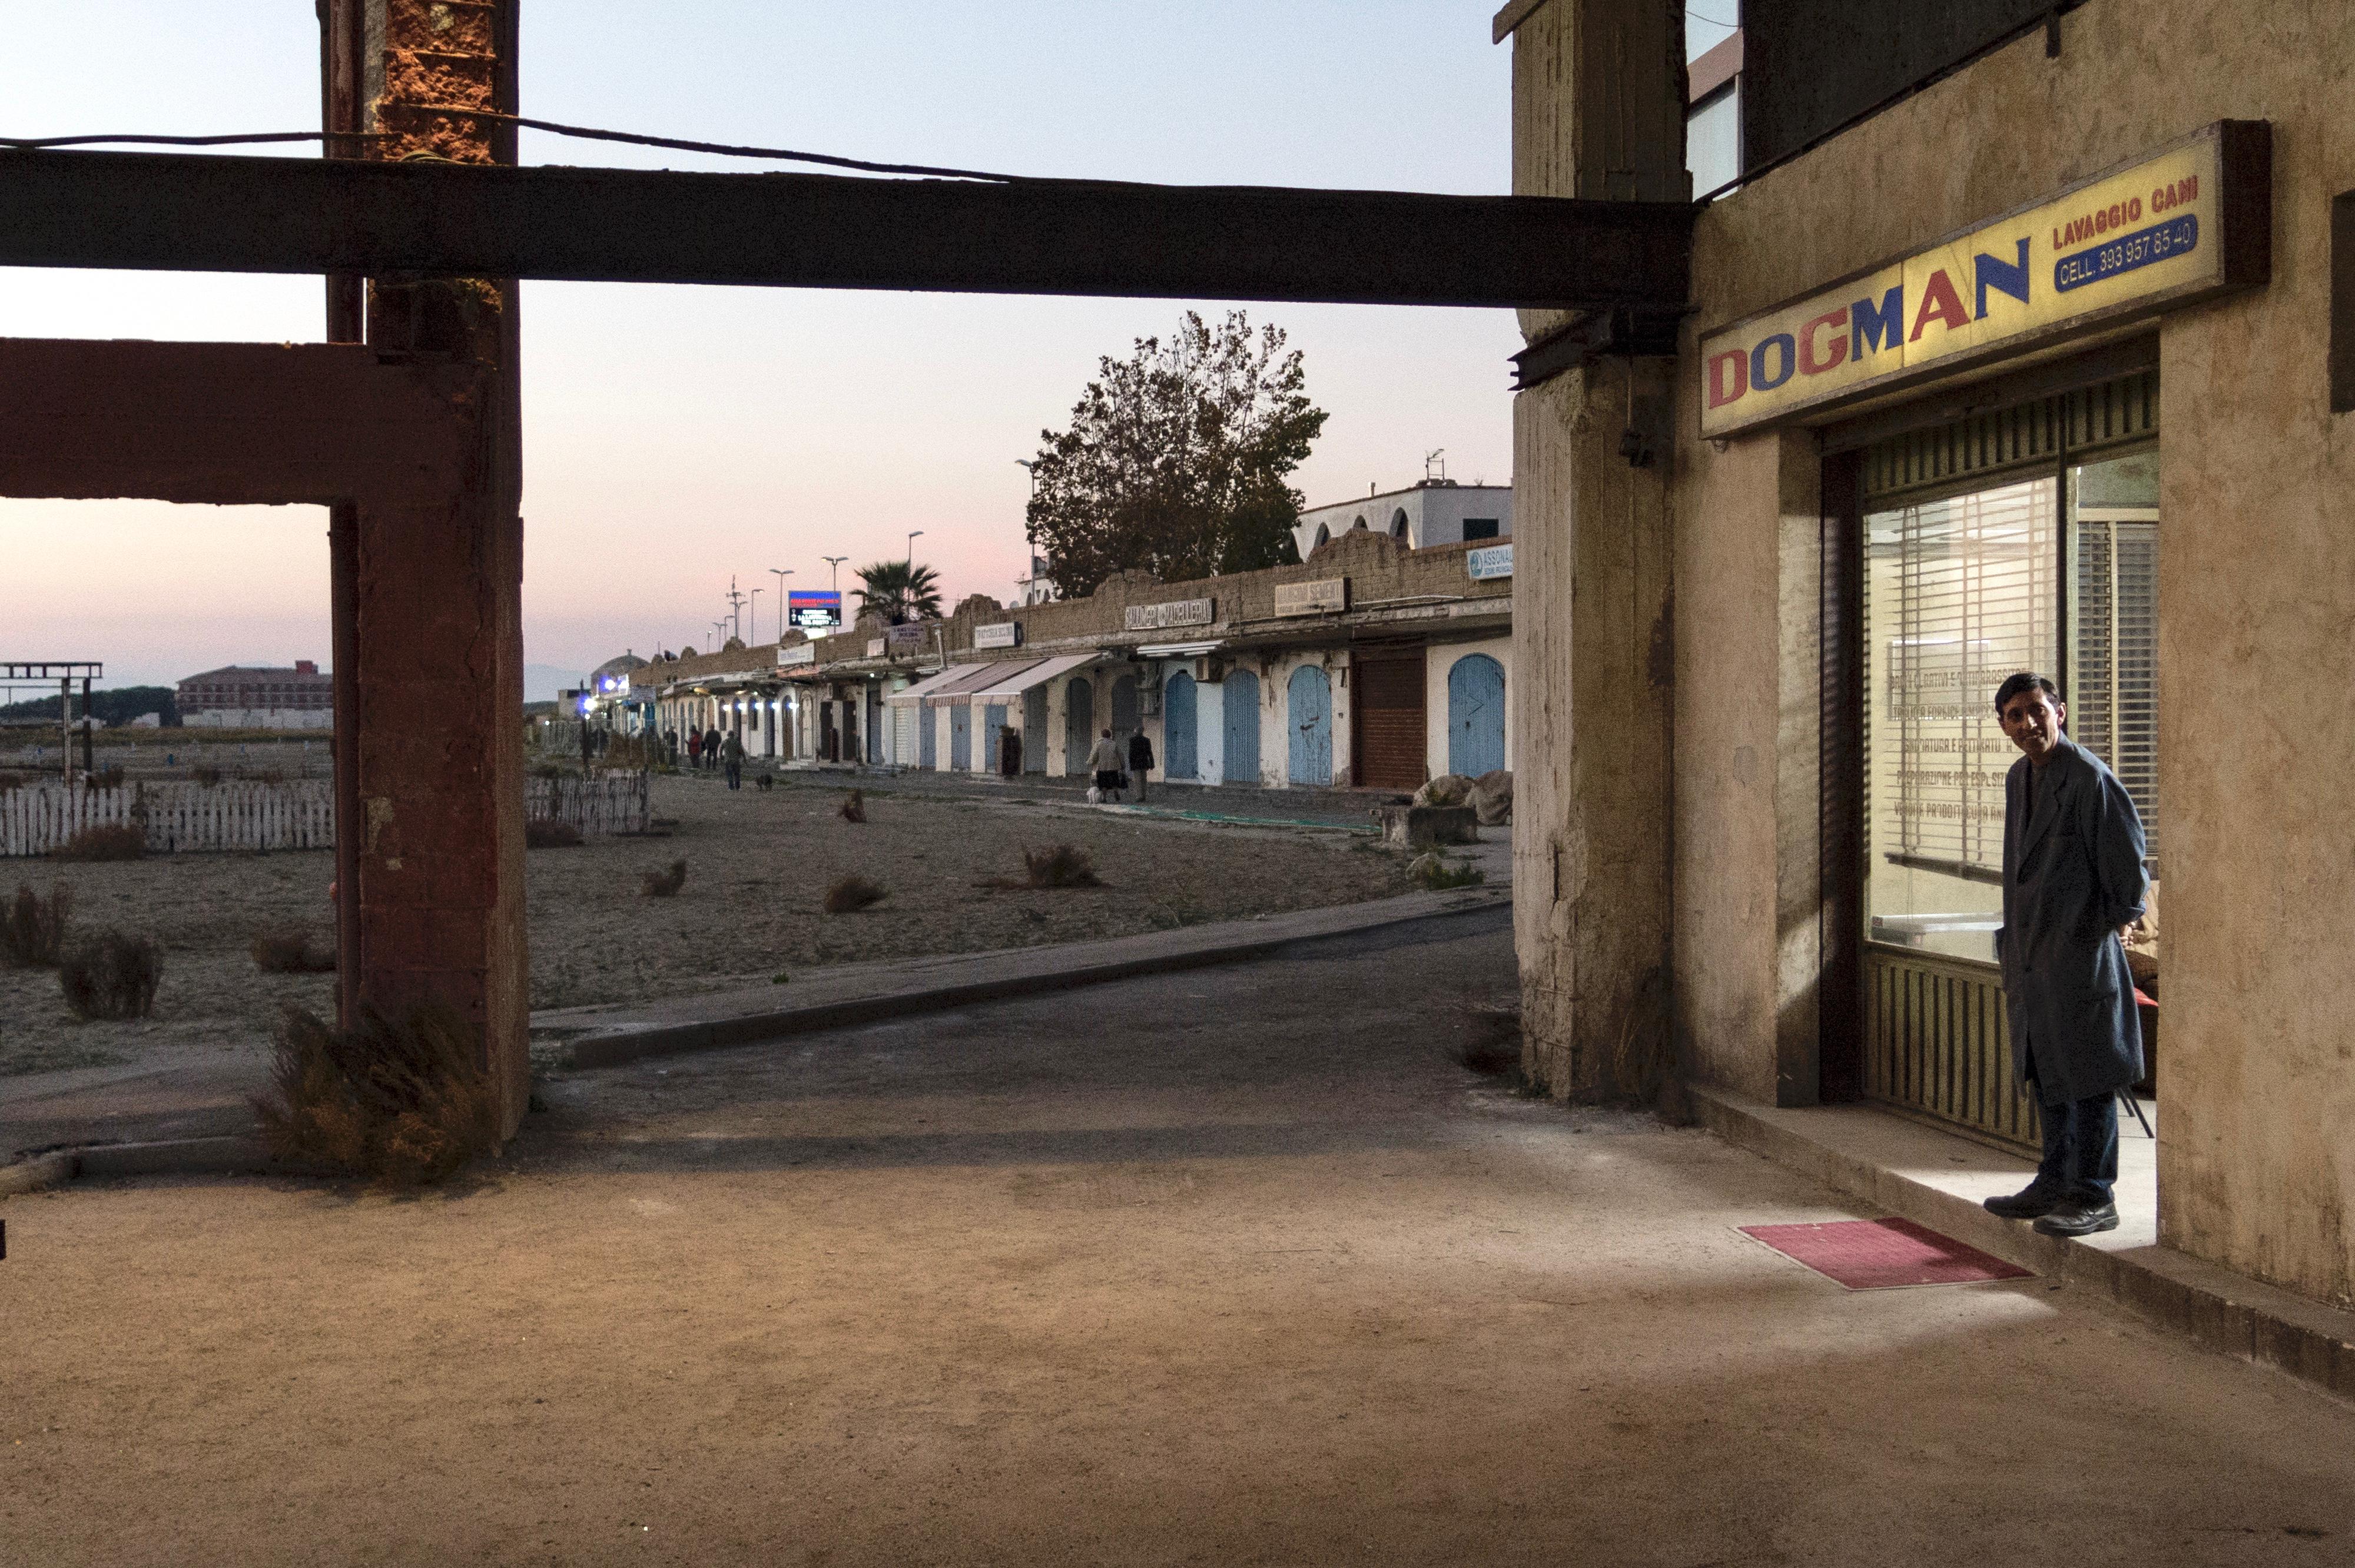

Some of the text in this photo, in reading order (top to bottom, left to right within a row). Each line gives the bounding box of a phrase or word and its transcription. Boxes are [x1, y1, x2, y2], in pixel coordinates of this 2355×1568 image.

[2054, 174, 2198, 250] LAVAGGIO CANI
[2060, 222, 2191, 285] CELL. 393 957 85 40
[1708, 235, 2032, 410] DOGMAN
[1914, 672, 1948, 688] CRATIVI
[1952, 738, 1956, 753] E
[1958, 738, 2012, 753] PETTINATUA
[1897, 770, 1951, 785] PEPARAZIONE
[1926, 803, 1966, 819] PRODOTT
